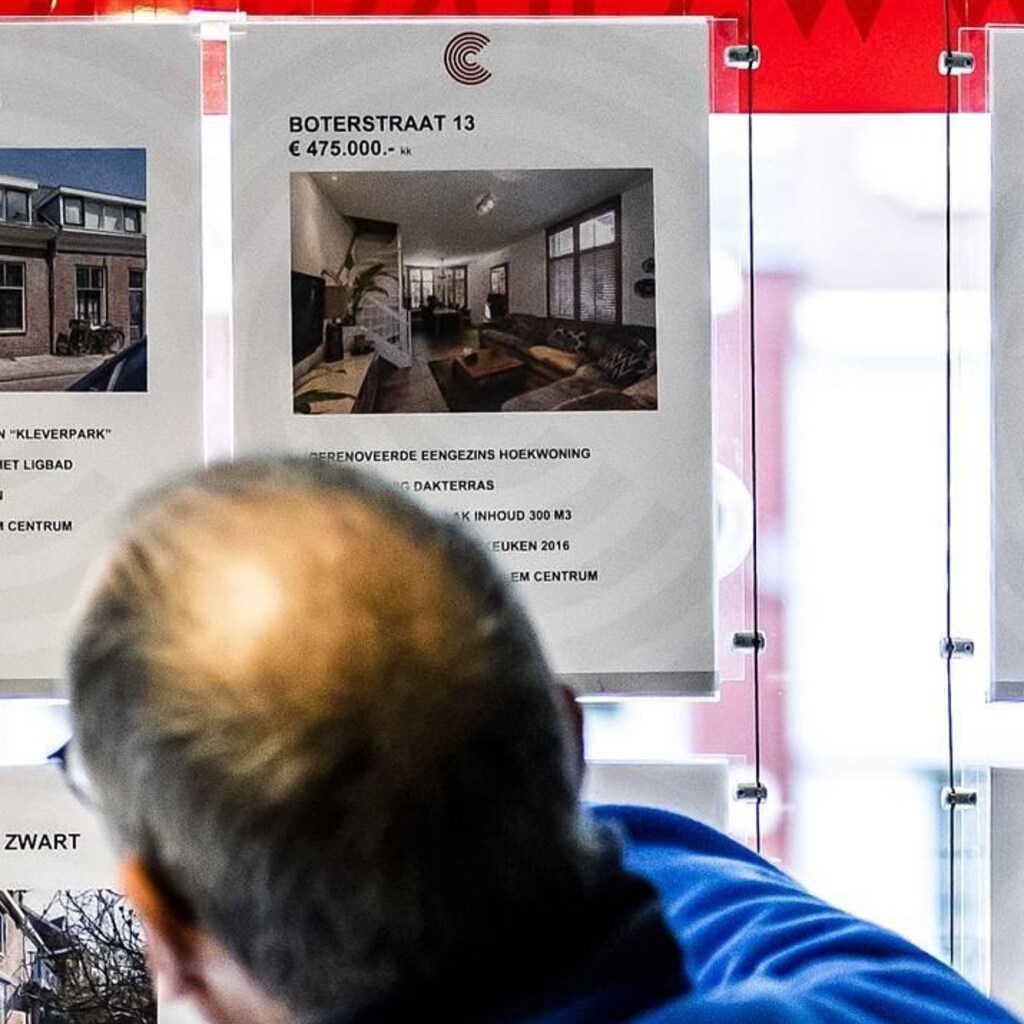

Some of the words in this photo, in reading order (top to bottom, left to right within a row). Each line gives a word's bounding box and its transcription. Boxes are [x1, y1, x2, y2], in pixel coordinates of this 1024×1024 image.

[288, 115, 447, 133] BOTERSTRAAT
[452, 114, 476, 132] 13
[288, 139, 302, 158] €
[305, 139, 396, 157] 475.000.-
[400, 146, 412, 156] kk
[9, 428, 112, 441] “KLEVERPARK”
[420, 449, 496, 462] EENGEZINS
[499, 447, 591, 461] HOEKWONING
[23, 458, 74, 471] LIGBAD
[413, 479, 495, 492] DAKTERRAS
[473, 509, 526, 522] INHOUD
[528, 509, 551, 522] 300
[553, 508, 573, 521] M3
[7, 520, 73, 533] CENTRUM
[533, 569, 599, 583] CENTRUM
[3, 832, 82, 851] ZWART
